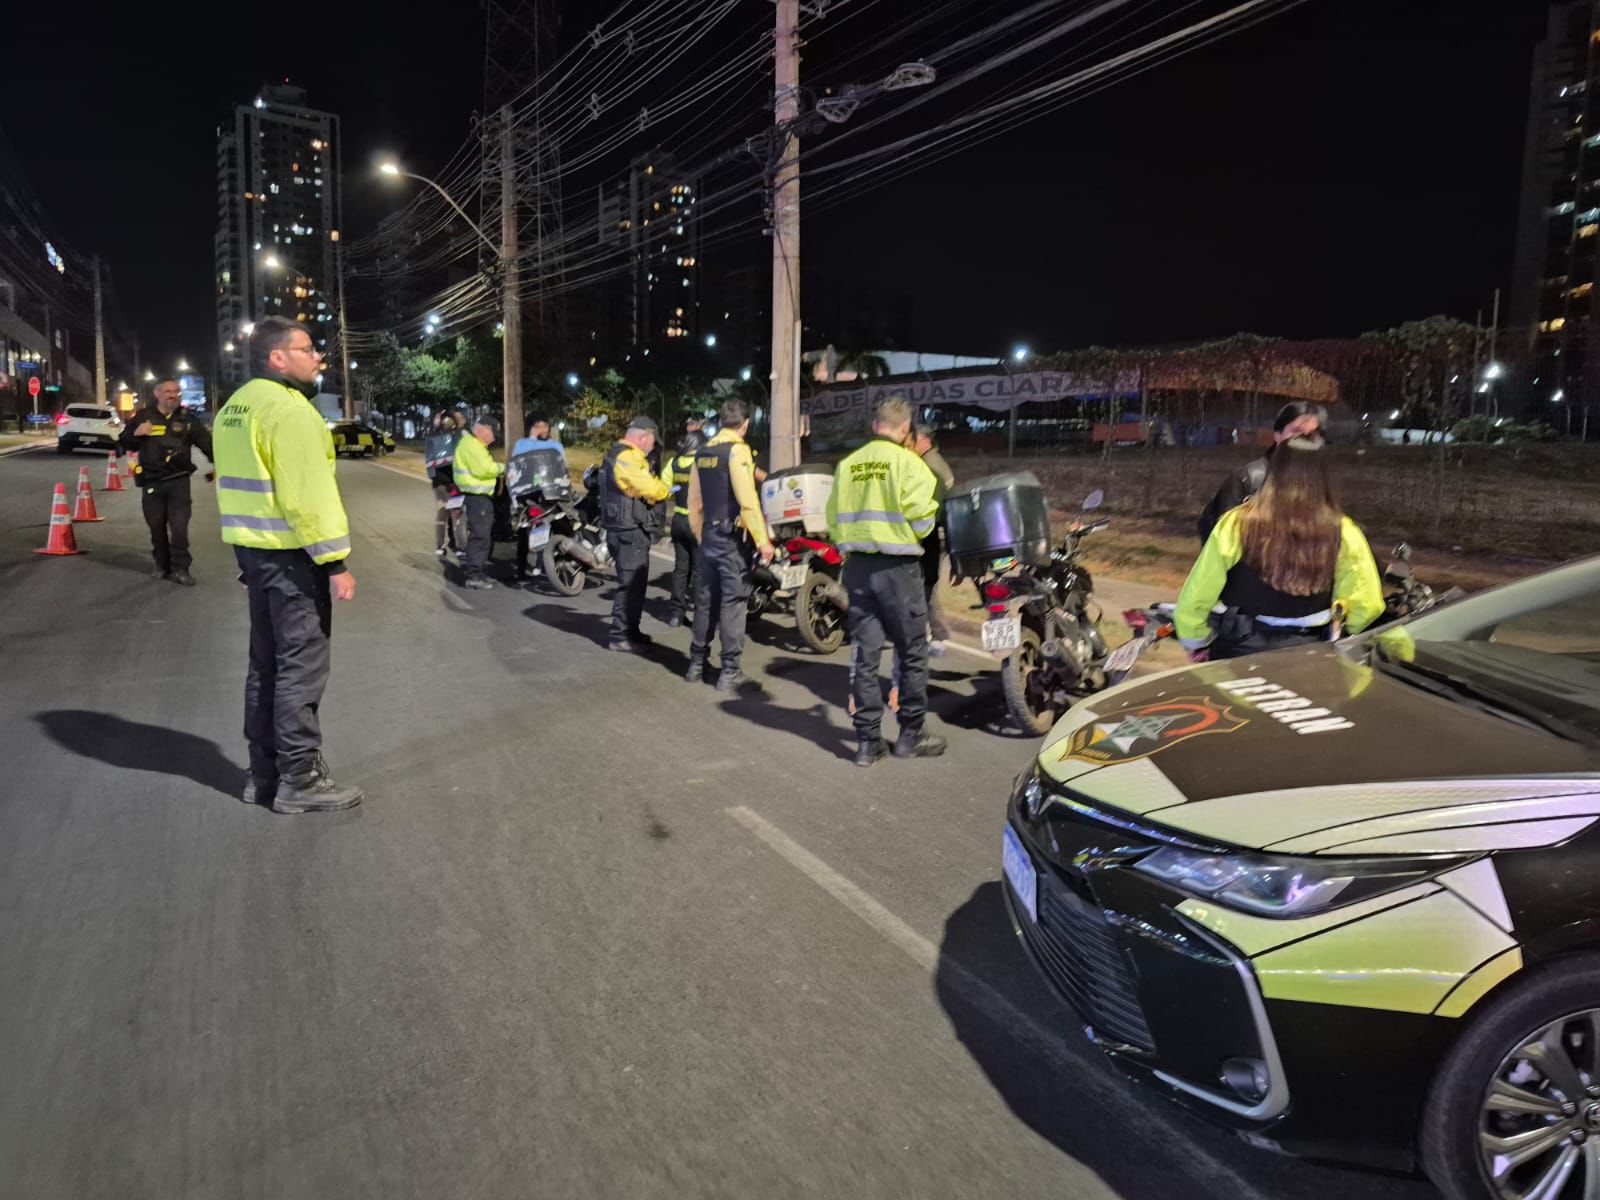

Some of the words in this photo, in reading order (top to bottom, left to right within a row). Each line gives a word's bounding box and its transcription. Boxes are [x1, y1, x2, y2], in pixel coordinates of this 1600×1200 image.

[834, 392, 865, 409] DE
[975, 373, 1098, 397] CLARA
[219, 404, 250, 416] ETRAN
[1216, 677, 1356, 735] DETRAN
